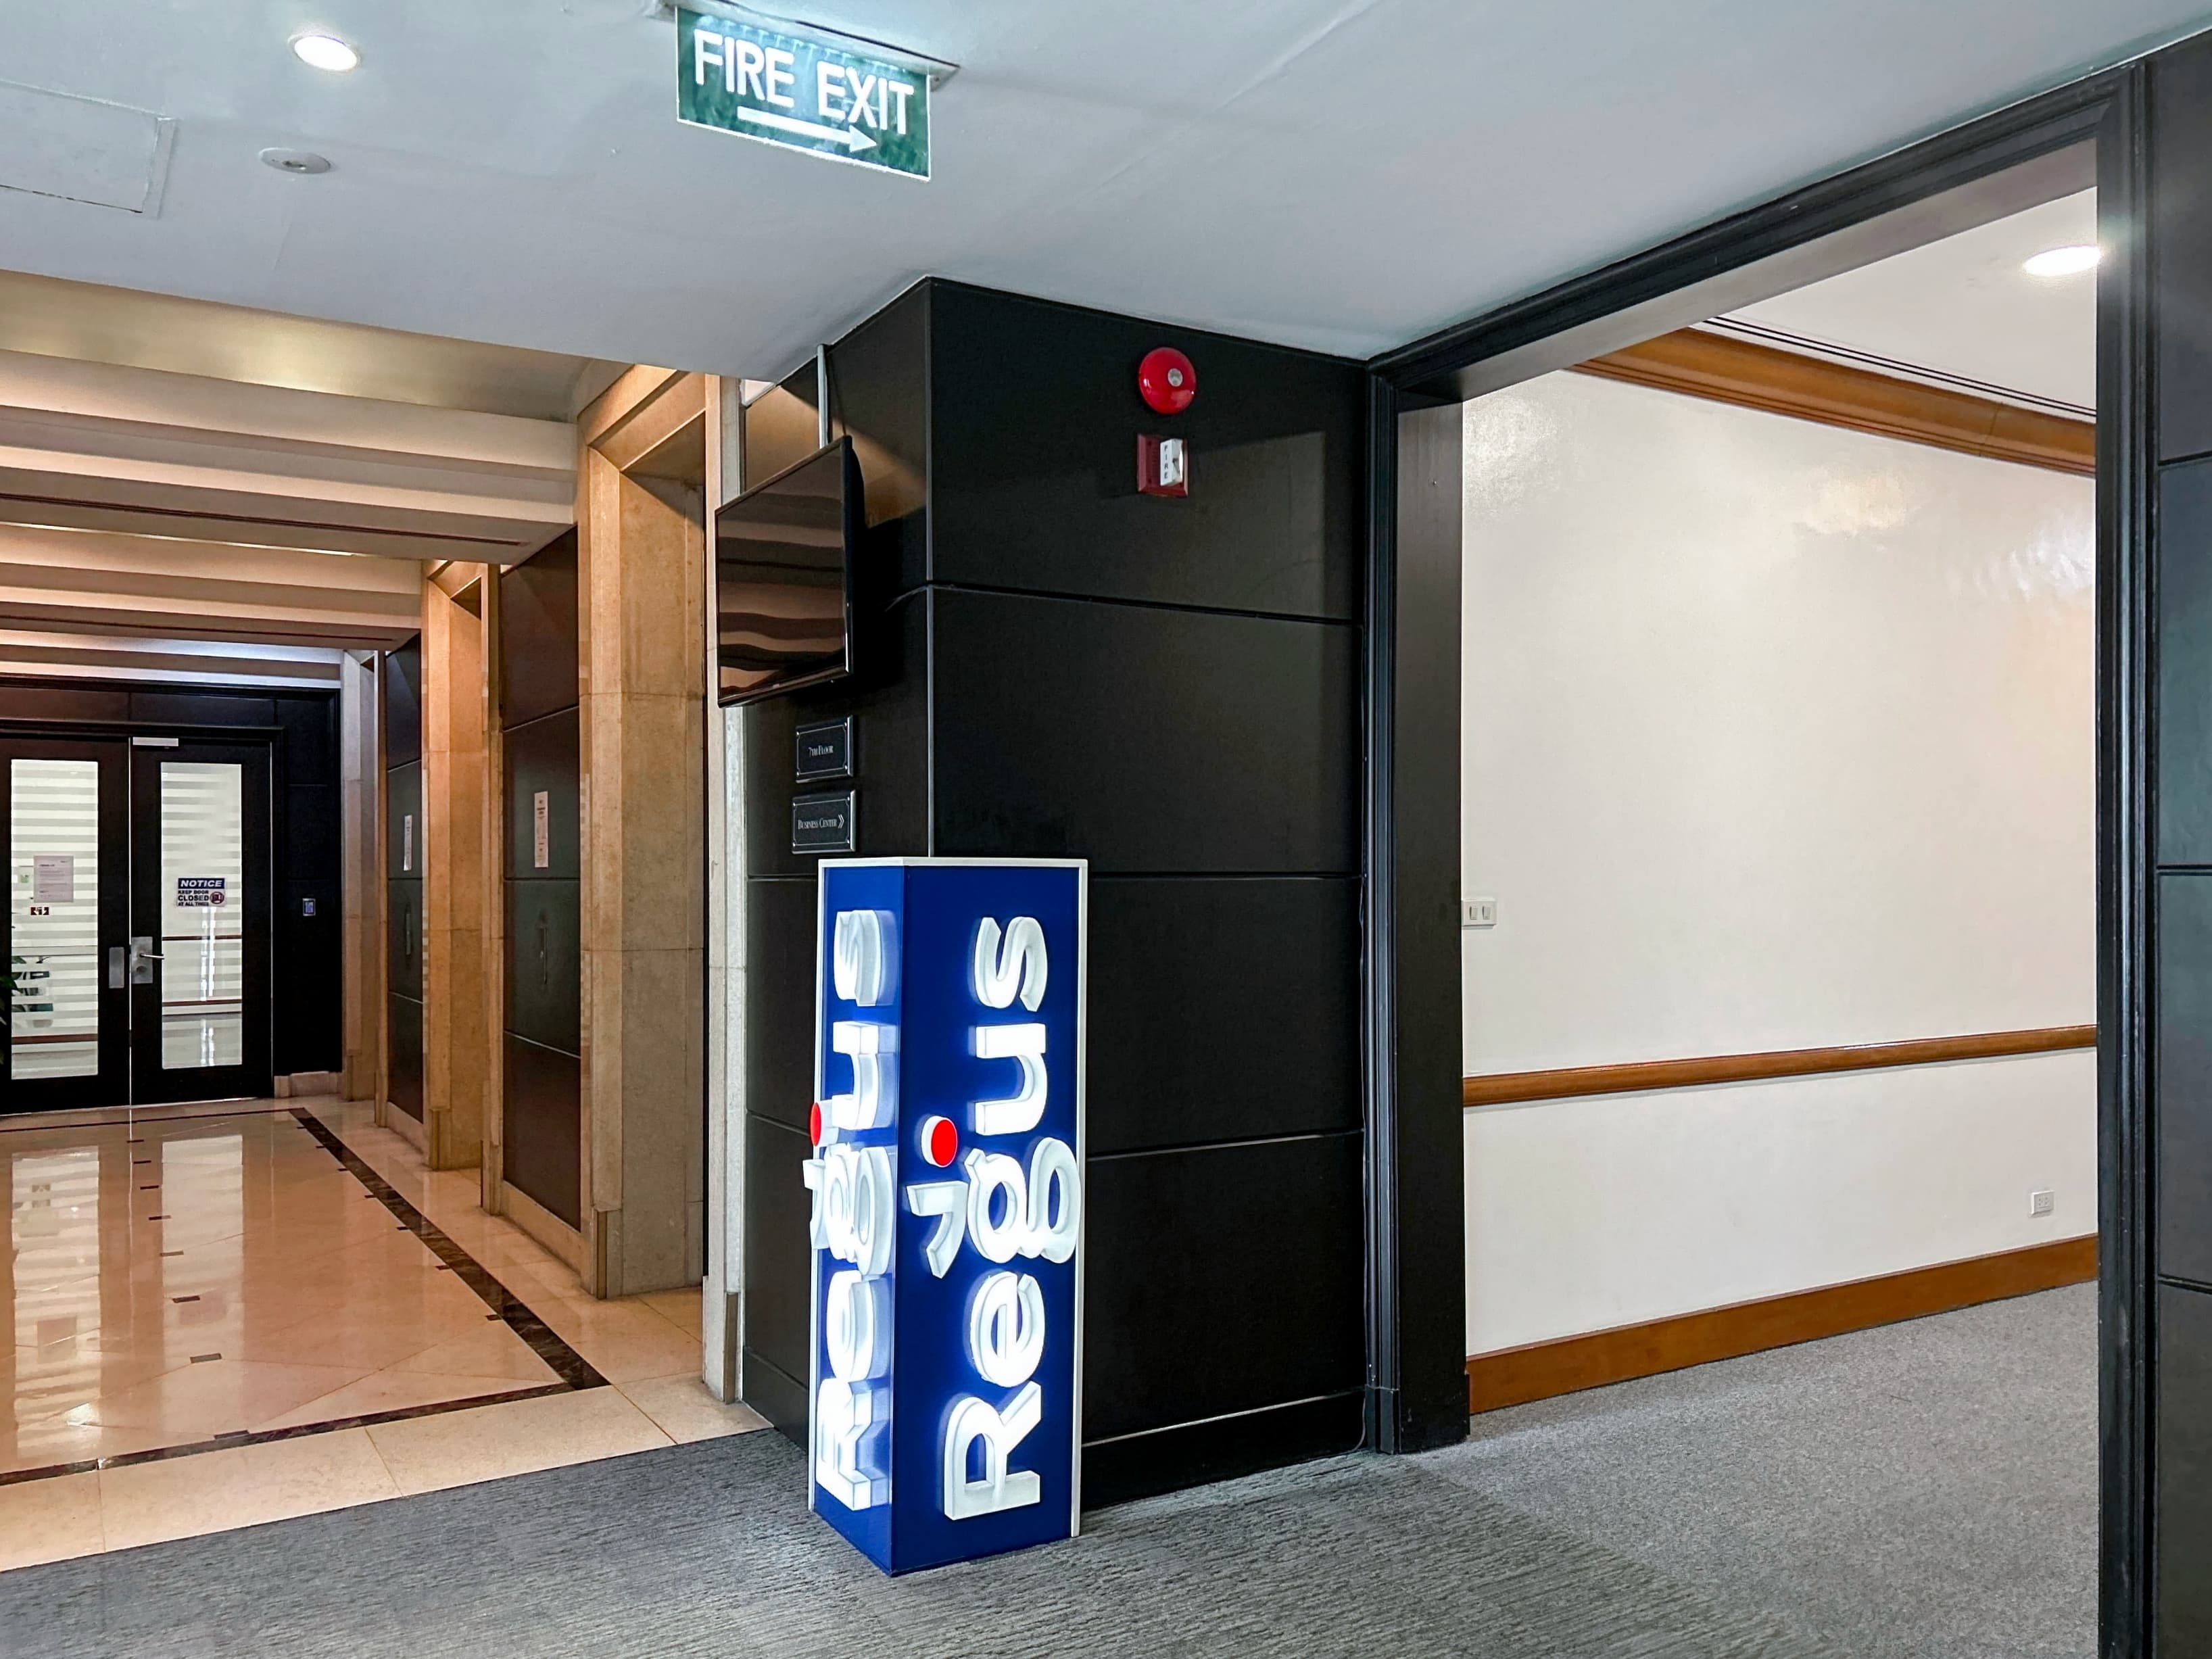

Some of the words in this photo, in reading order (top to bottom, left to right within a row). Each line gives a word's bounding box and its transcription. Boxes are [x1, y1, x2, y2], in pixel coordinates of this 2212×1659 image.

[694, 28, 795, 108] FIRE
[817, 61, 914, 135] EXIT
[819, 817, 838, 827] CENTER
[944, 915, 1080, 1522] Regus
